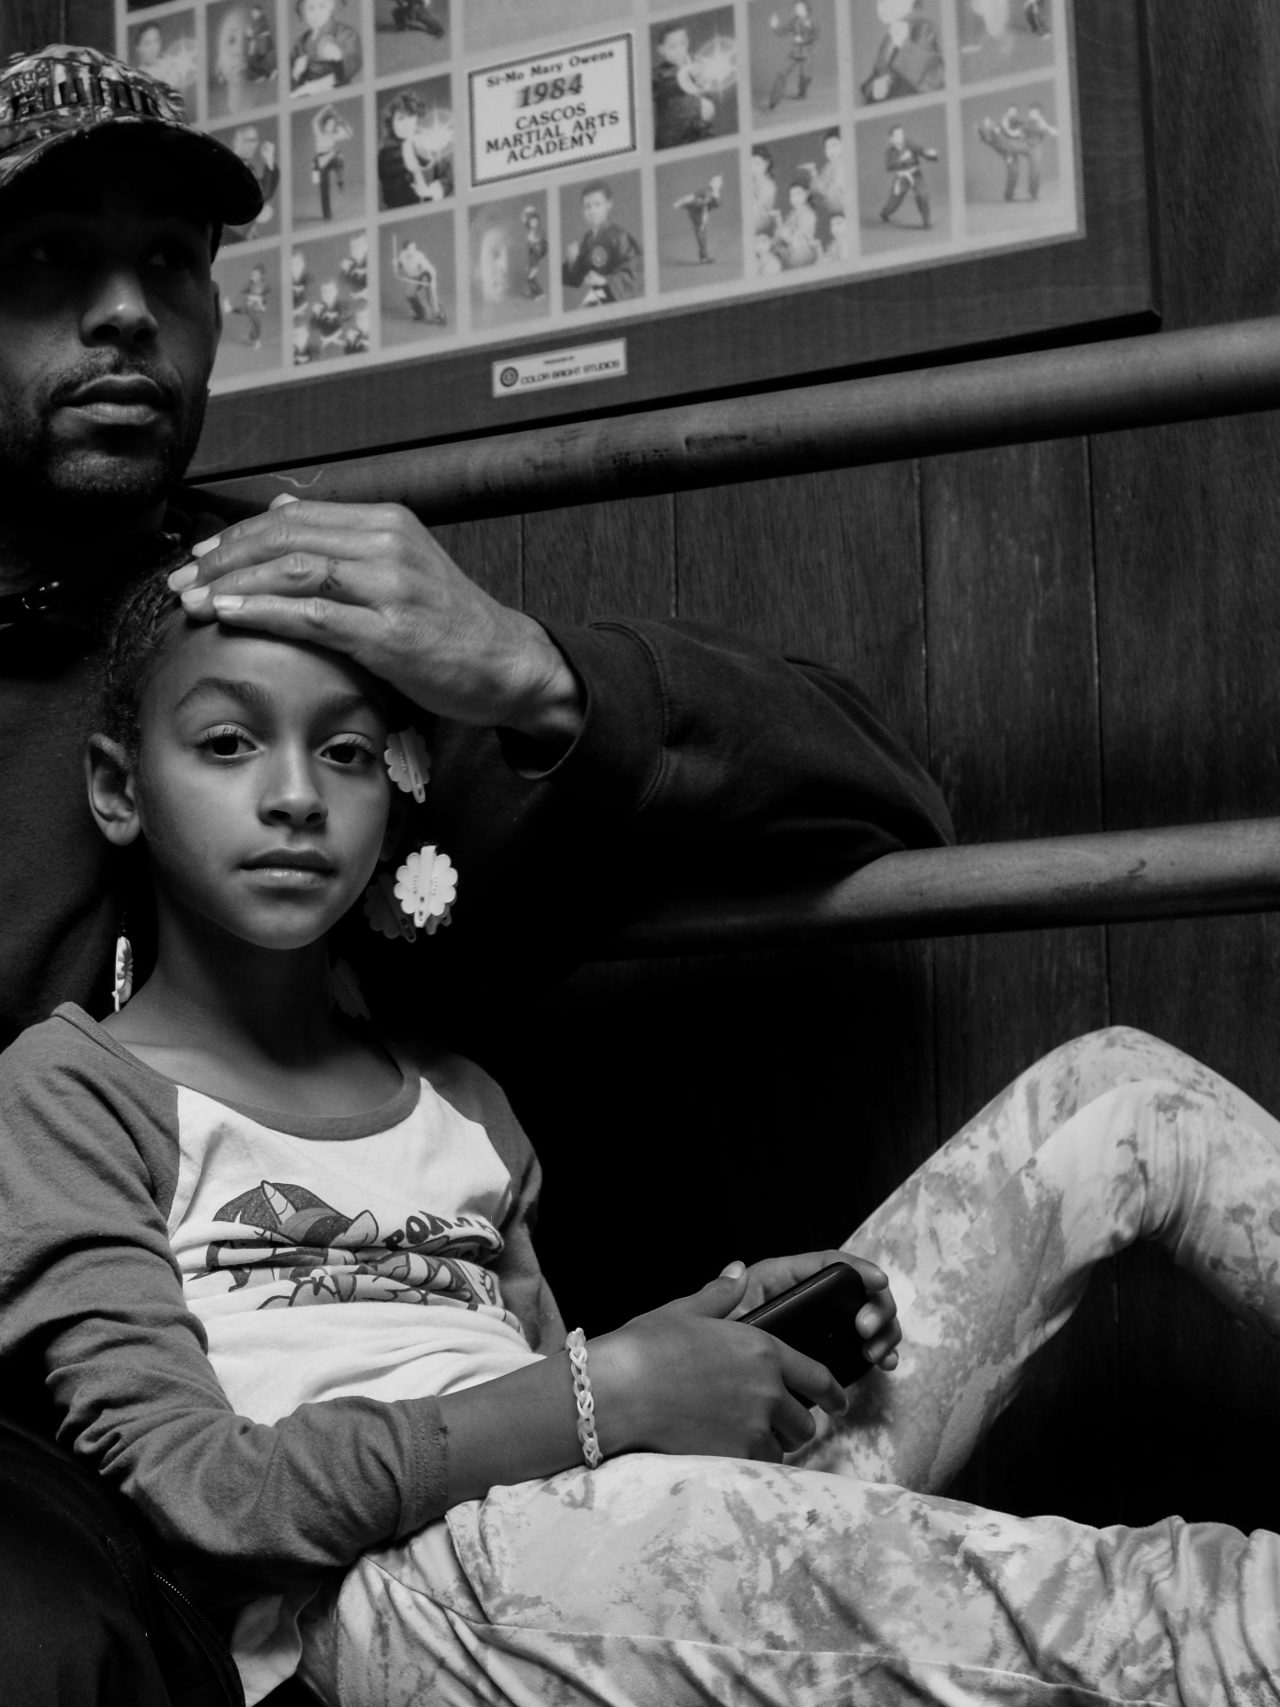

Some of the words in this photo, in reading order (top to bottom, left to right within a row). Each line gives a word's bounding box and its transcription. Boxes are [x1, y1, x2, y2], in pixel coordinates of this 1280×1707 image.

[529, 62, 564, 77] Mary
[568, 50, 615, 67] Owens
[516, 73, 583, 108] 1984
[485, 124, 565, 154] MARTIAL
[572, 110, 620, 134] ARTS
[515, 102, 587, 131] CASCOS
[506, 130, 597, 164] ACADEMY
[521, 372, 550, 385] COLOR
[551, 366, 581, 379] BRIGHT
[583, 359, 620, 374] STUDIOS
